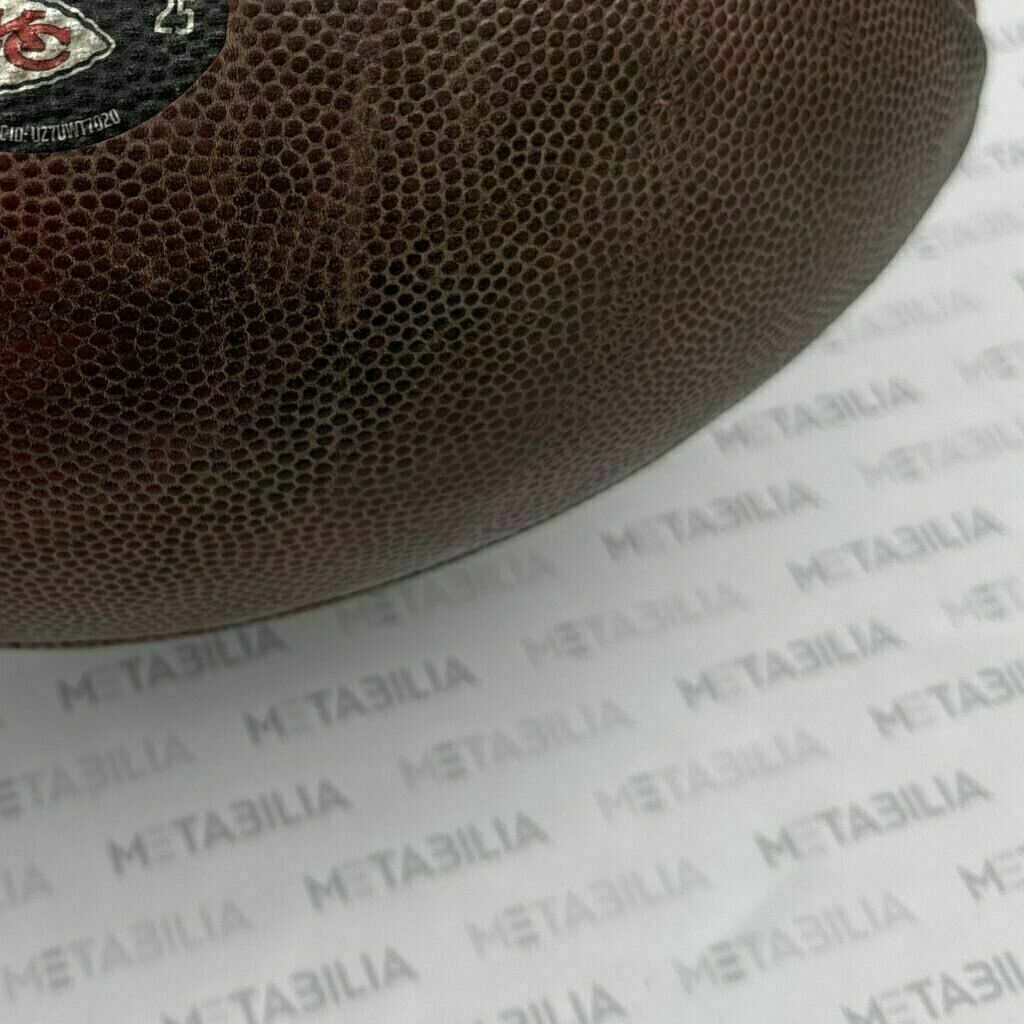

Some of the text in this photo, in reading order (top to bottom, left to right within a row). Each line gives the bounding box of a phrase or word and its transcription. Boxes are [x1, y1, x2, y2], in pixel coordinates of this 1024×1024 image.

[785, 505, 1011, 593] METABILIA
[56, 623, 290, 712] METABILIA
[242, 653, 482, 746] METABILIA
[676, 616, 907, 711] METABILIA
[105, 777, 353, 877] METABILIA
[302, 808, 554, 913] METABILIA
[753, 767, 995, 868] METABILIA
